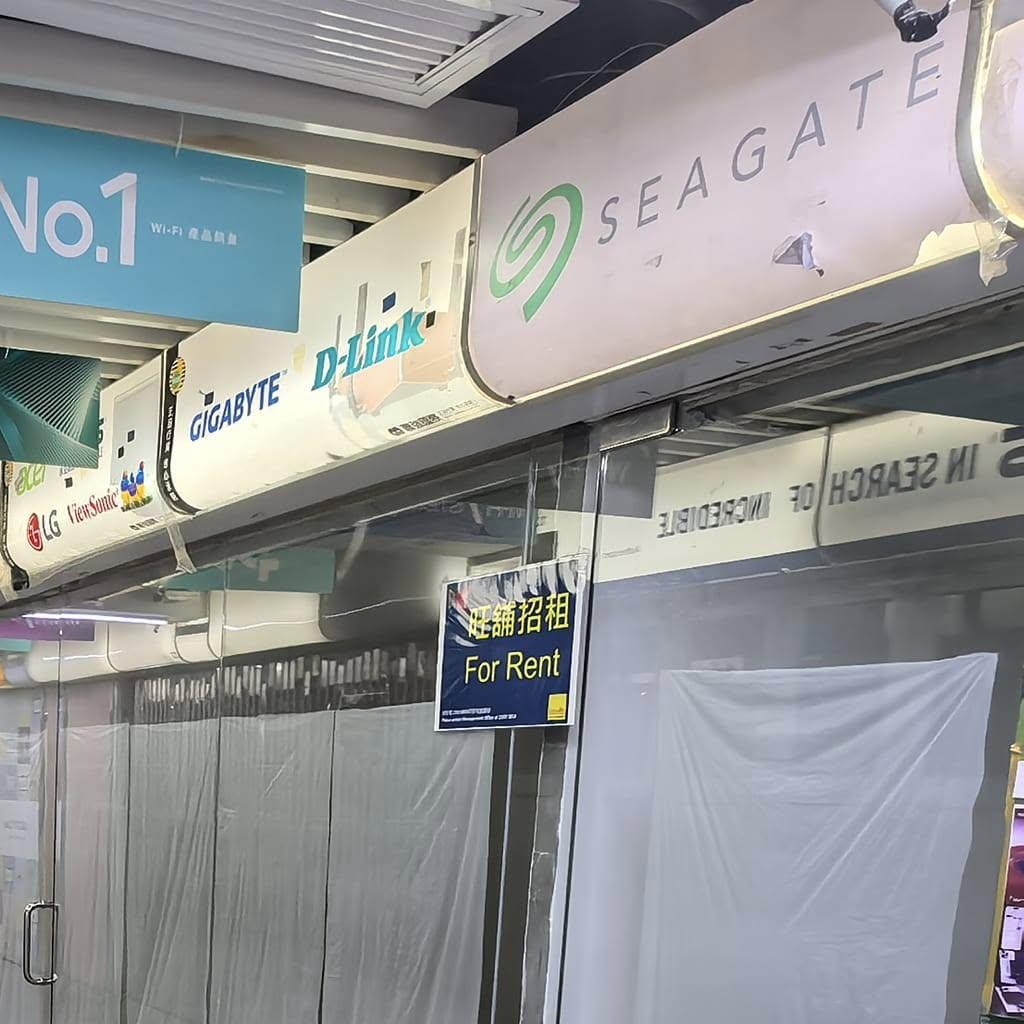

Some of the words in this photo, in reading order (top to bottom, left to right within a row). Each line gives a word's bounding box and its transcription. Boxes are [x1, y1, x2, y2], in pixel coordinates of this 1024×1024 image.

[598, 40, 945, 247] SEAGATE
[311, 307, 426, 392] D-Link
[189, 372, 282, 442] GIGABYTE
[67, 488, 119, 525] ViewSonic
[468, 592, 570, 640] 旺舖招租
[464, 656, 500, 684] For
[506, 648, 561, 681] Rent
